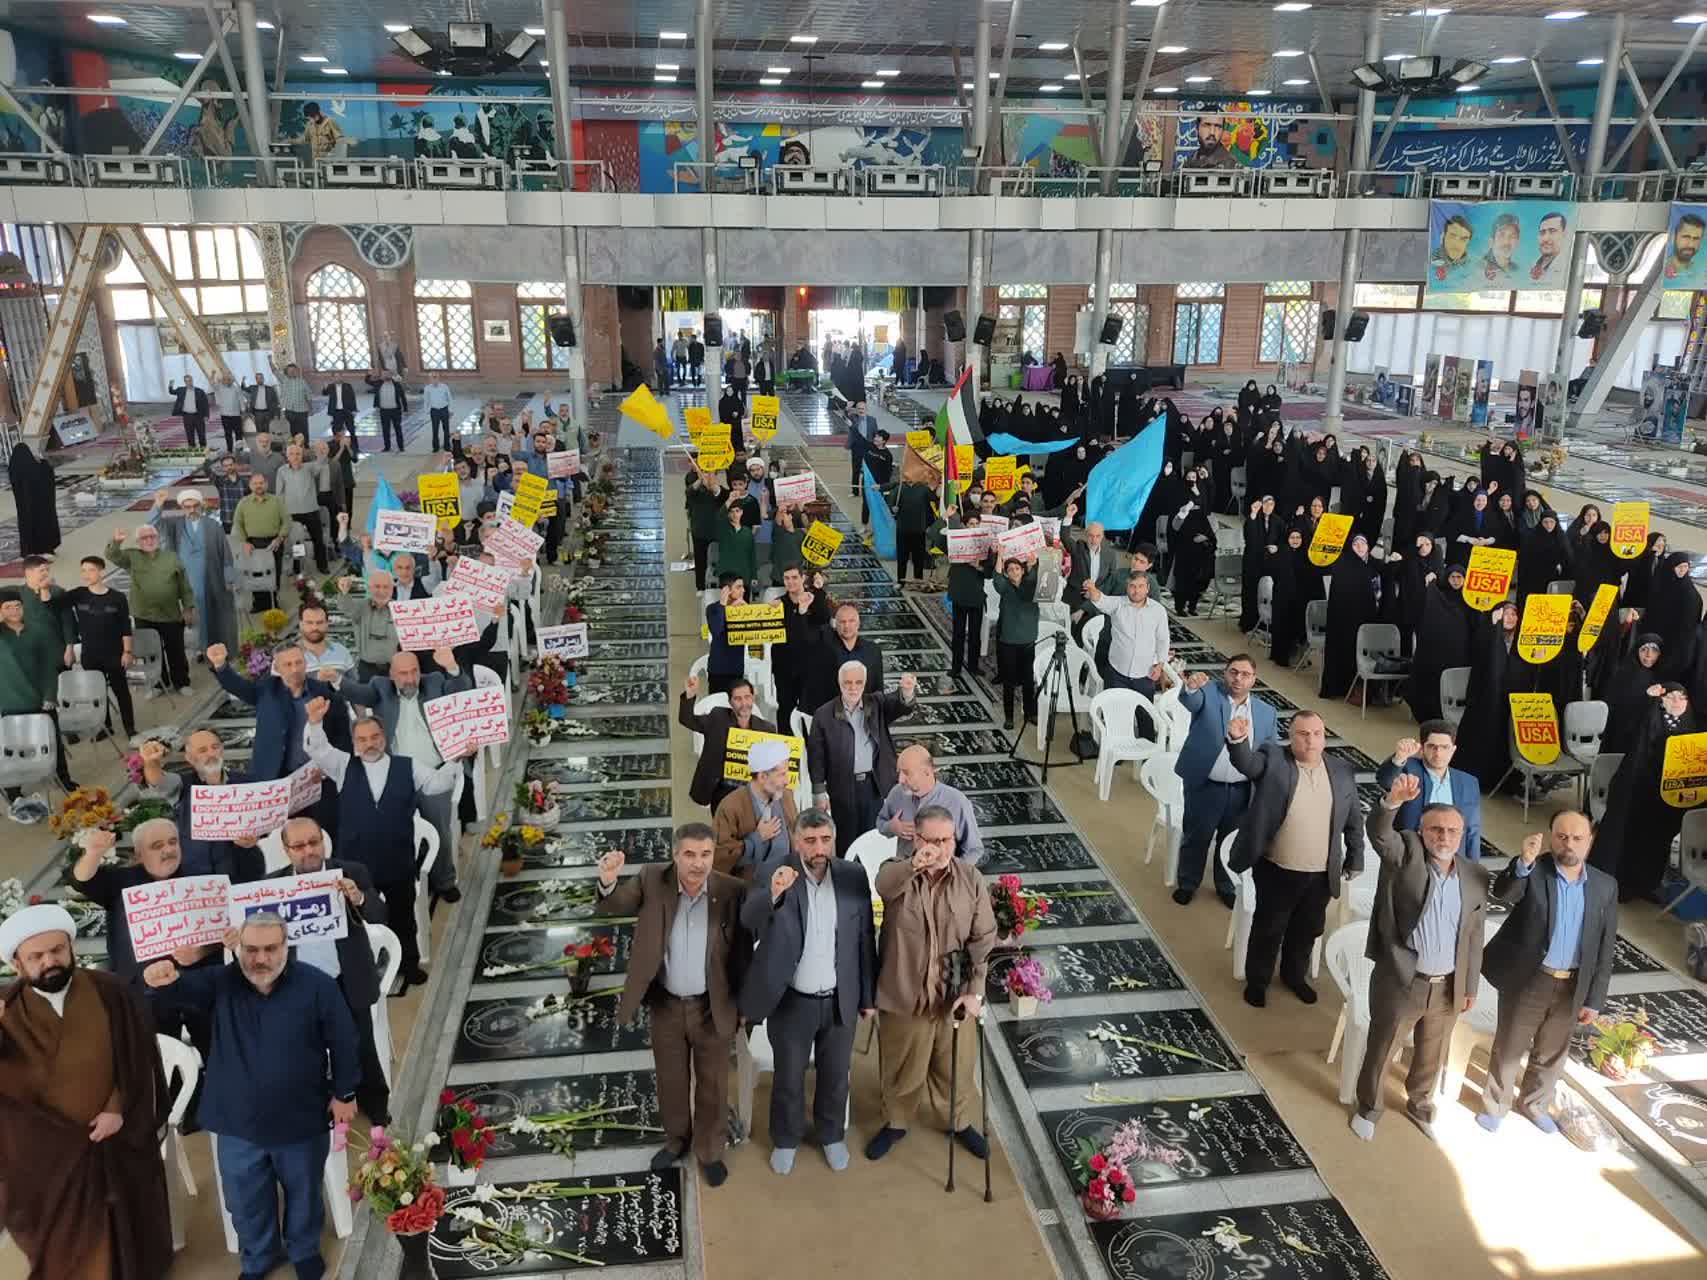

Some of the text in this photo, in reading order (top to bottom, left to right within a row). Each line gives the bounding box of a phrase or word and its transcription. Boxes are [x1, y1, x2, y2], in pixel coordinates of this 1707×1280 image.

[754, 415, 775, 429] USA
[990, 479, 1010, 490] USA
[426, 501, 457, 515] USA
[1616, 528, 1642, 542] USA
[807, 540, 829, 557] USA
[1470, 577, 1501, 593] USA
[446, 598, 469, 610] مرگ
[754, 610, 763, 618] بر
[763, 607, 782, 617] مرگ
[464, 697, 473, 709] بر
[477, 692, 502, 705] مرگ
[469, 725, 478, 737] بر
[481, 719, 505, 732] مرگ
[1521, 728, 1553, 741] USA
[195, 783, 286, 803] مرگ بر آمریکا
[247, 815, 257, 828] بر
[127, 879, 228, 906] مرگ بر آمریکا
[292, 901, 327, 921] رمز
[194, 916, 205, 931] بر
[288, 917, 340, 941] آمریکای
